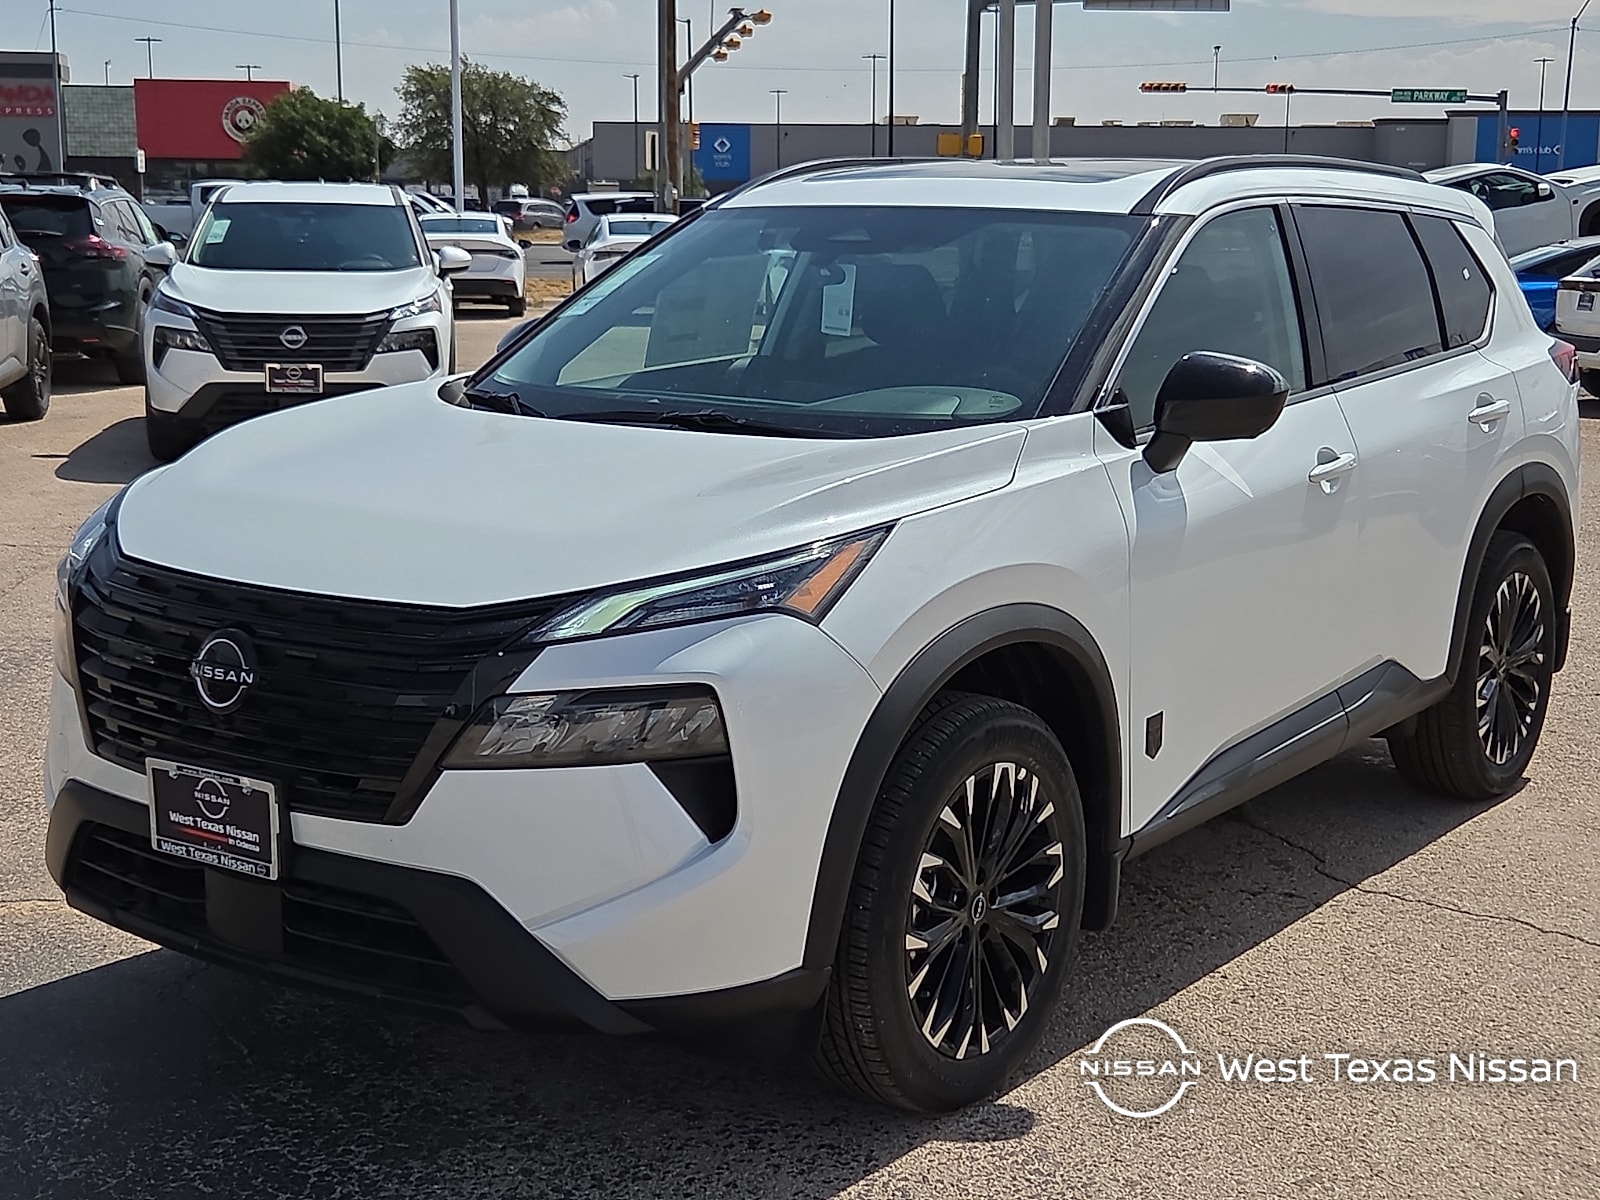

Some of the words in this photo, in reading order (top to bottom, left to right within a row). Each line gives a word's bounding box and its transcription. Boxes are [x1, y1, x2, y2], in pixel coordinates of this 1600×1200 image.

[1413, 91, 1449, 101] PARKWAY
[0, 107, 53, 115] PRESS
[190, 661, 254, 684] NISSAN
[194, 791, 231, 806] NISSAN
[168, 810, 195, 827] West
[195, 817, 225, 834] Texas
[225, 824, 260, 843] Nissan
[160, 840, 187, 857] West
[188, 846, 219, 863] Texas
[220, 854, 256, 874] Nissan
